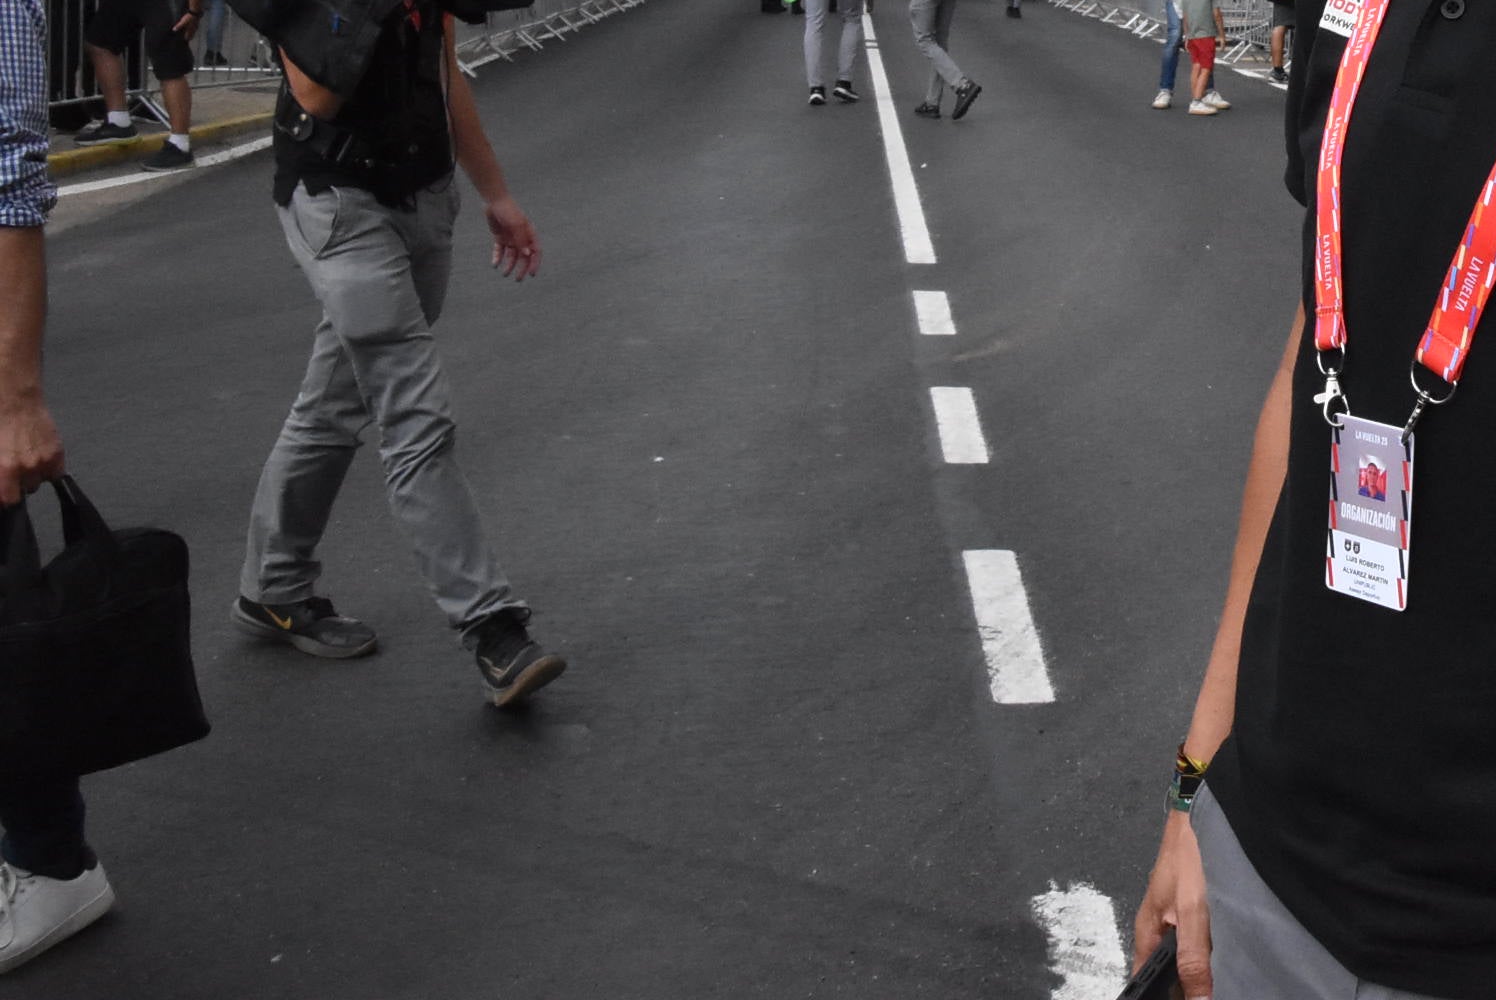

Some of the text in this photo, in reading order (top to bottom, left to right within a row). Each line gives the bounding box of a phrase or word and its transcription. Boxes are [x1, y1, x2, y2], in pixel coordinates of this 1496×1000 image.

[1454, 256, 1485, 312] LA VUELTA
[1340, 501, 1396, 532] ORGANIZACIÓN
[1342, 566, 1389, 585] ALVAREZ MARTIN
[1345, 554, 1385, 572] LUIS ROBERTO
